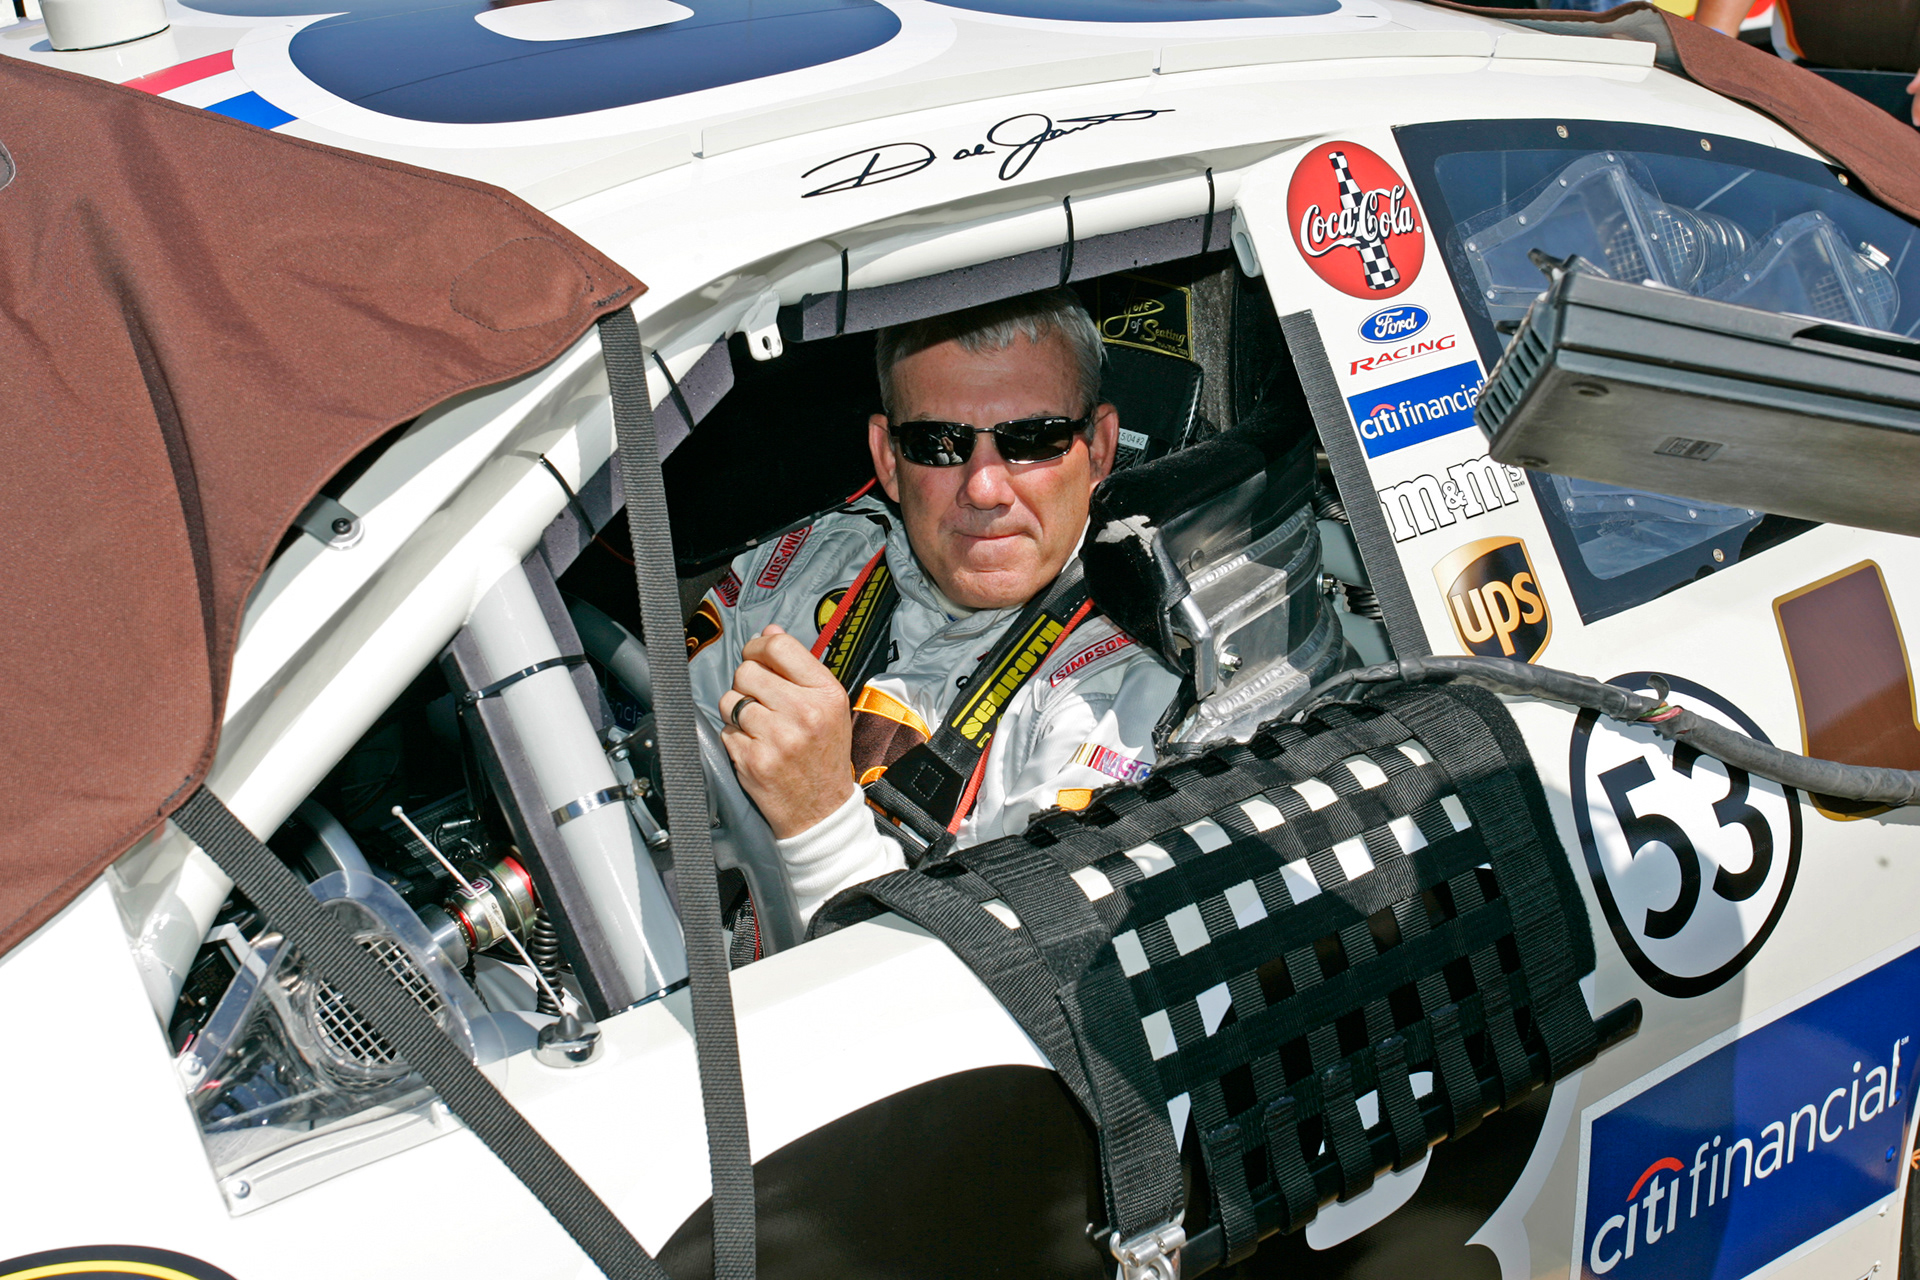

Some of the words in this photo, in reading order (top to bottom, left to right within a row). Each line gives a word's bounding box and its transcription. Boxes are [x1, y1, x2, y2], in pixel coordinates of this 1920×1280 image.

[1131, 318, 1143, 334] of
[1140, 319, 1187, 347] Seating
[1374, 309, 1418, 338] Ford
[1349, 334, 1456, 376] RACING
[761, 528, 807, 584] SIMPSON
[1451, 571, 1544, 657] ups
[1055, 633, 1131, 681] SIMPSON
[1598, 737, 1775, 940] 53
[1590, 1038, 1901, 1276] citifinancial
